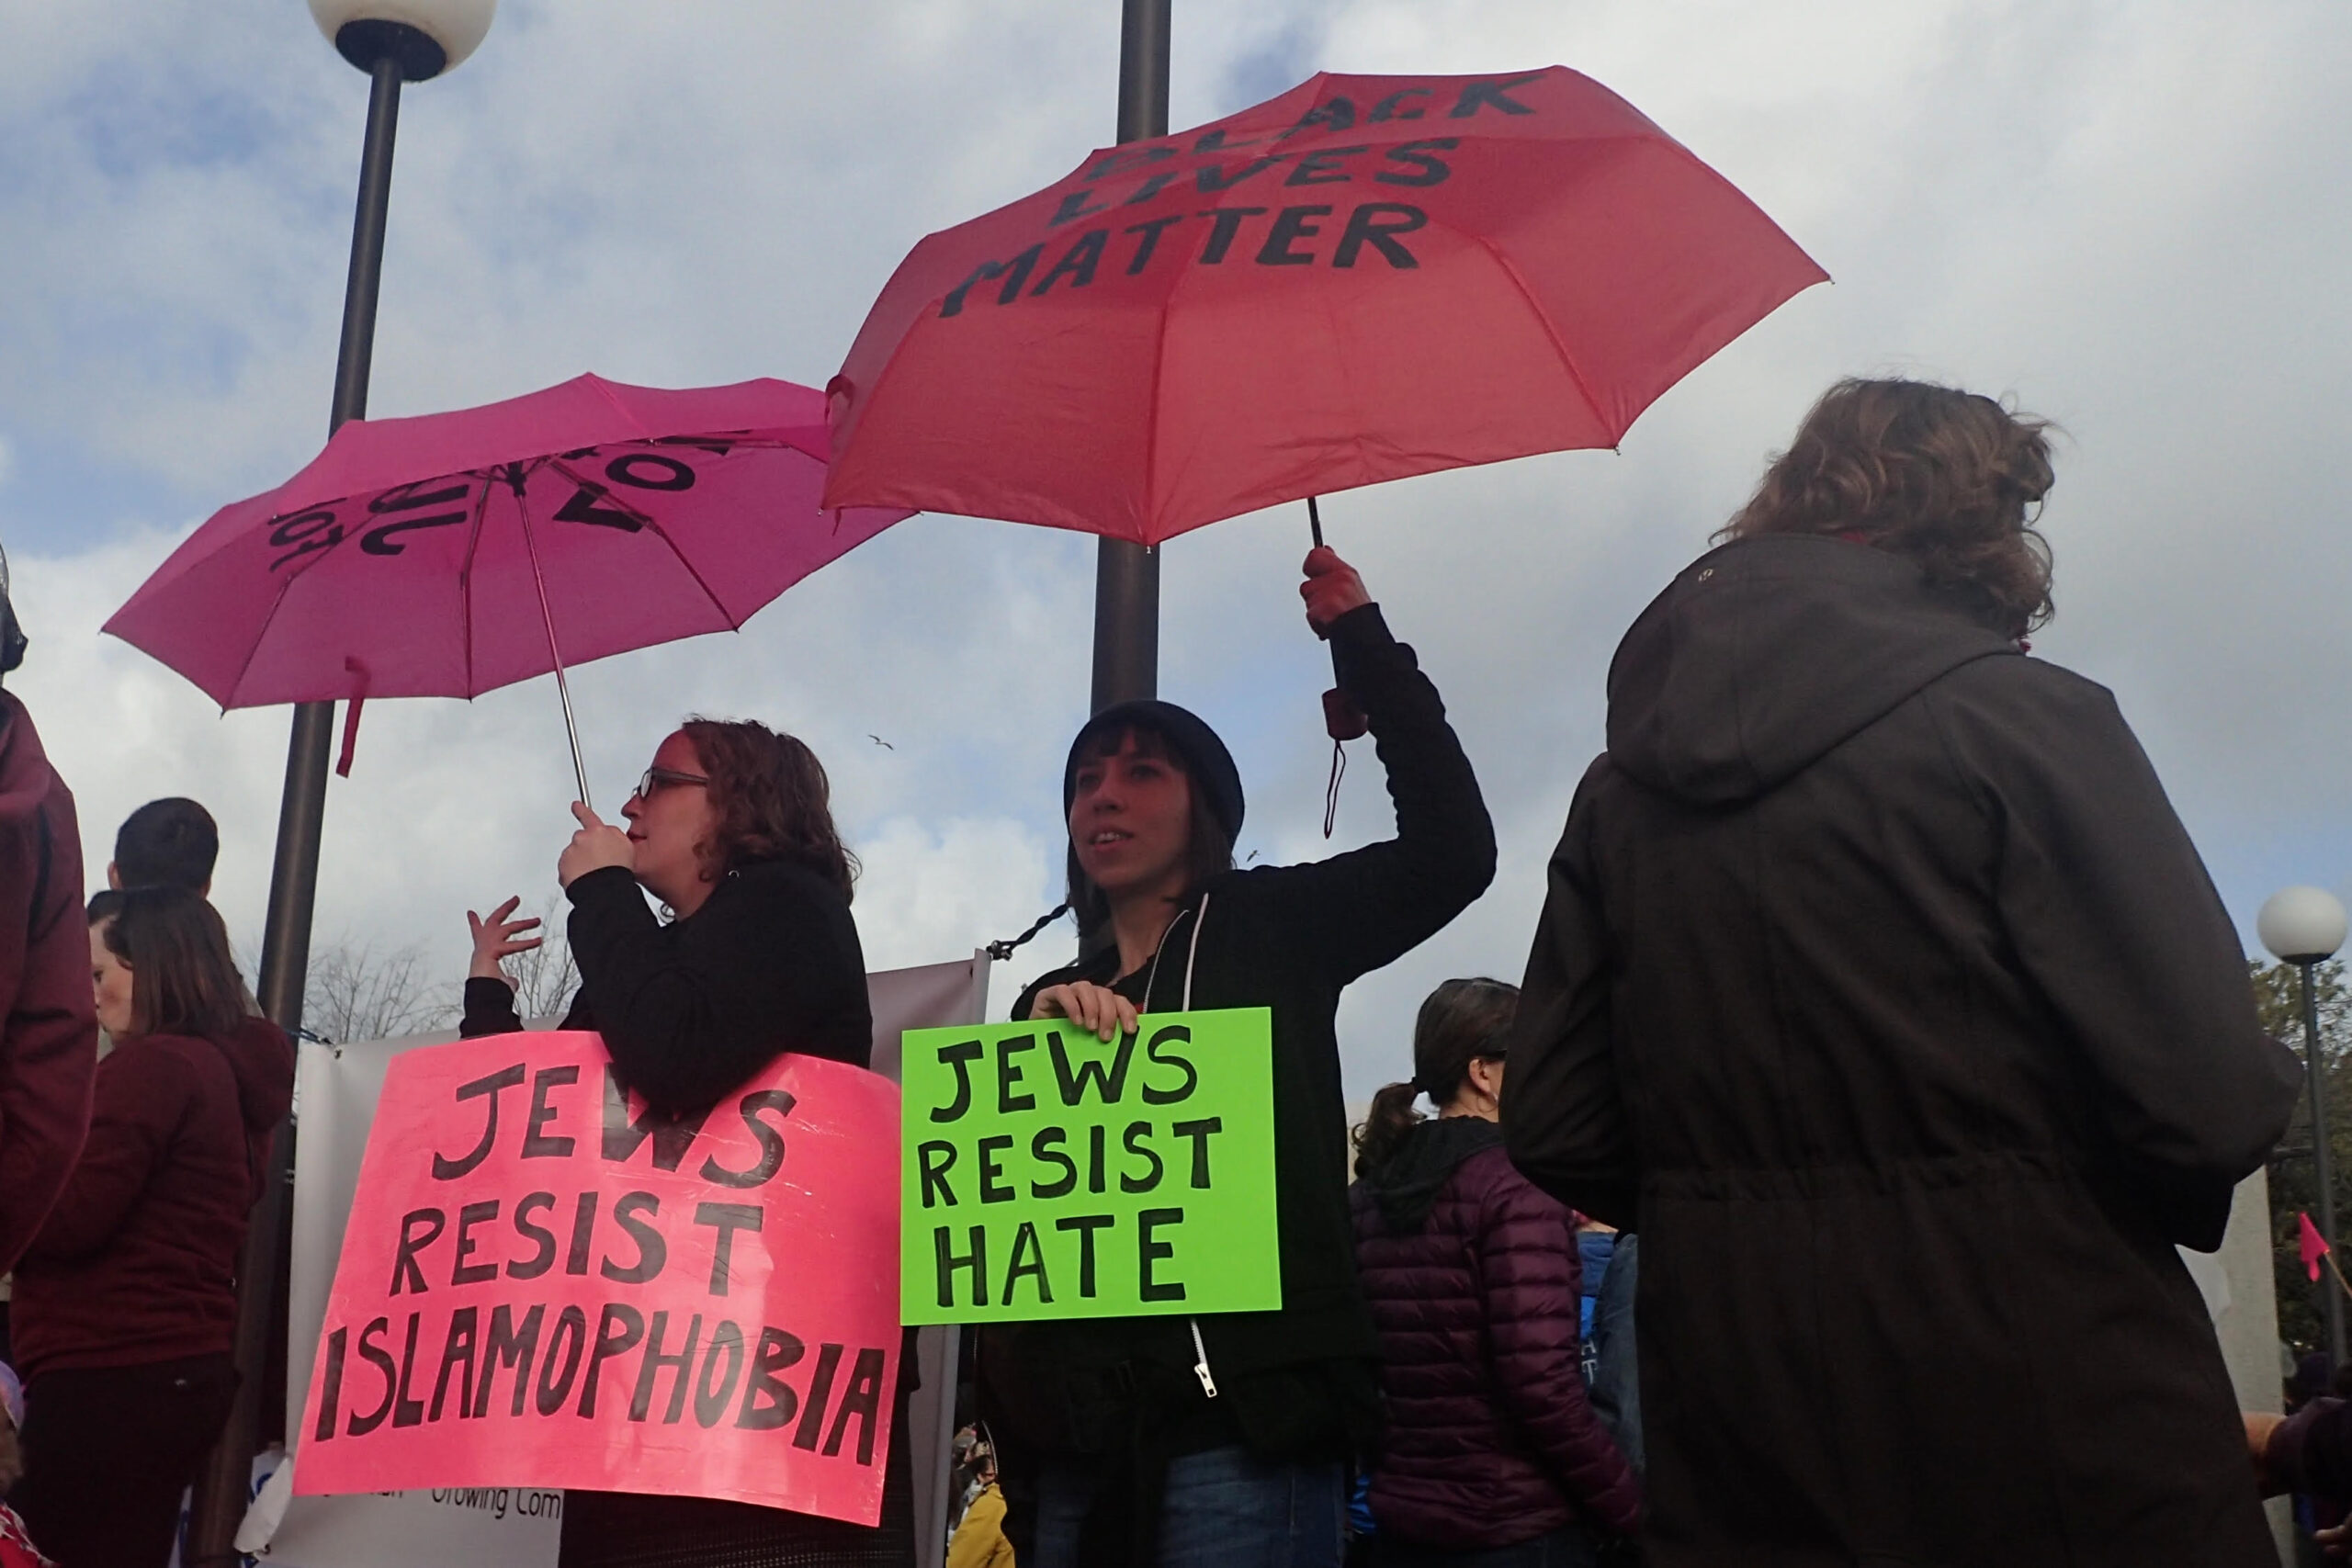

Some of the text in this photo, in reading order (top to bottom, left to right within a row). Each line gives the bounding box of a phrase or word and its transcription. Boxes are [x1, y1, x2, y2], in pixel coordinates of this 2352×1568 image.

[1081, 73, 1548, 181] BLACK
[1047, 137, 1461, 227] LIVES
[939, 202, 1429, 319] MATTER
[431, 1062, 797, 1190] JEWS
[930, 1024, 1198, 1123] JEWS
[917, 1116, 1223, 1209] RESIST
[389, 1191, 763, 1298] RESIST
[933, 1207, 1187, 1308] HATE
[314, 1303, 886, 1467] ISLAMOPHOBIA
